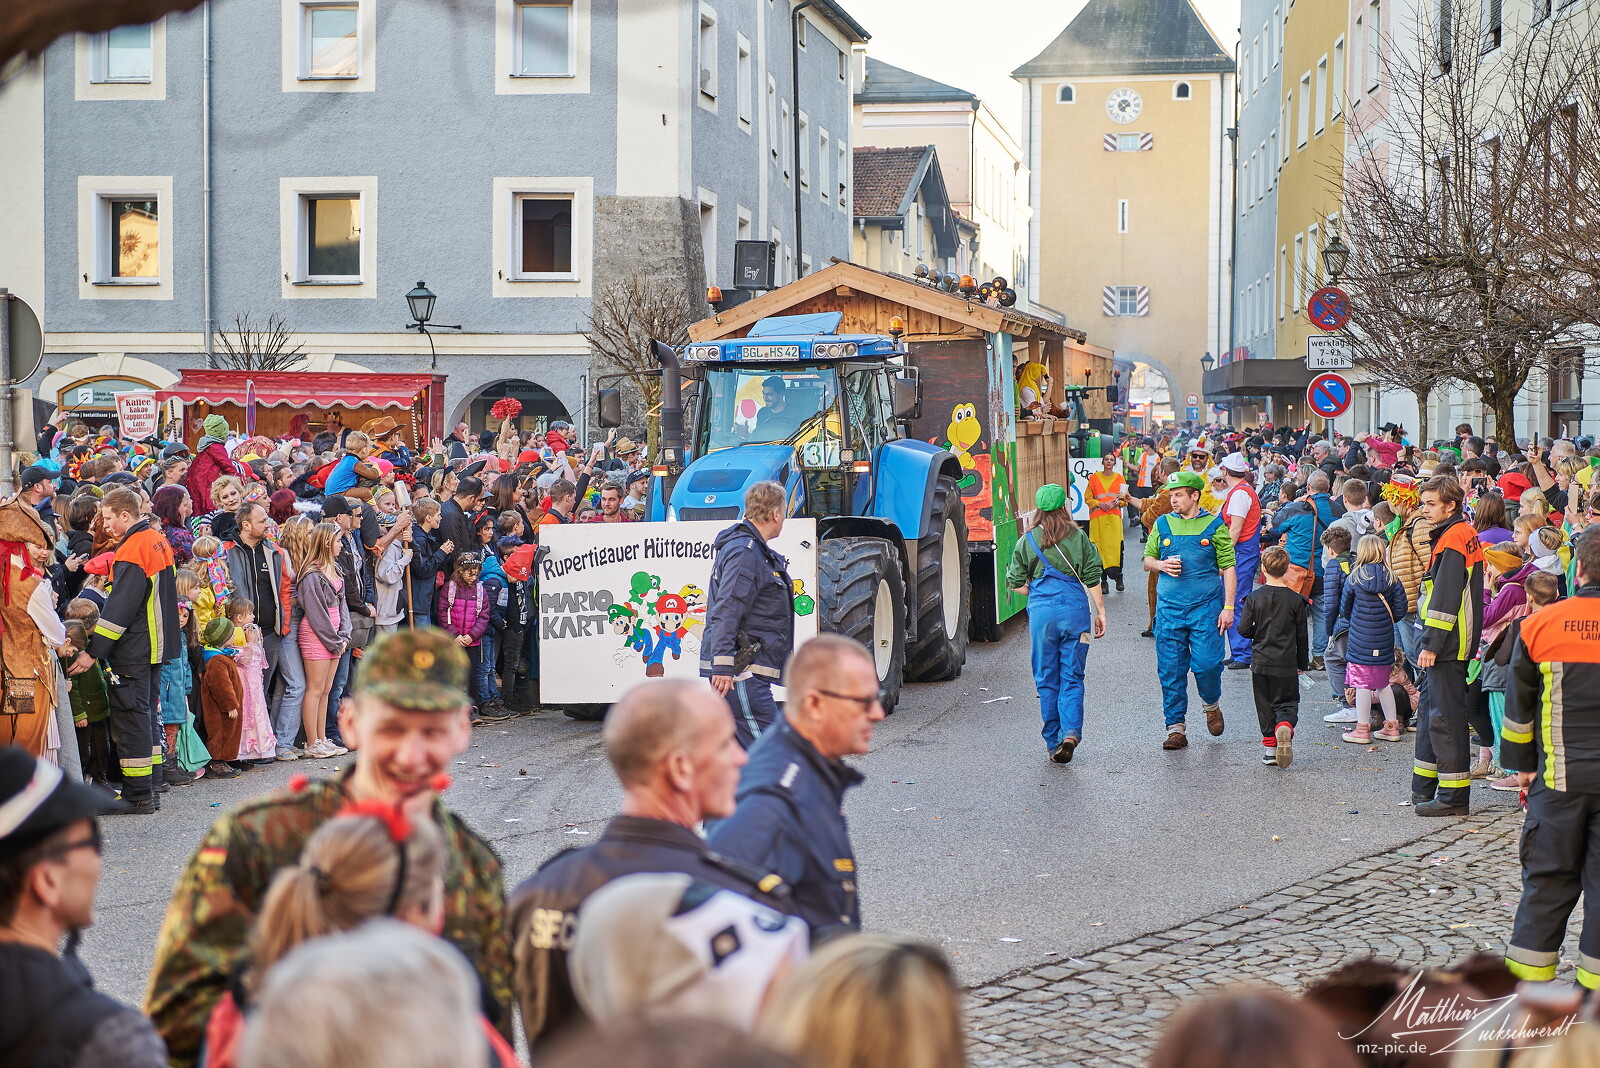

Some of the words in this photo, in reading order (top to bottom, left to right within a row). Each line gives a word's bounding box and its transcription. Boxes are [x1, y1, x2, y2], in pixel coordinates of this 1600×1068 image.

[1311, 340, 1350, 349] werktags
[743, 347, 763, 358] BGL
[769, 347, 784, 358] HS
[785, 346, 798, 358] 42
[1340, 357, 1345, 366] h
[125, 398, 151, 406] Kaffee
[123, 413, 155, 421] Cappuccino
[1170, 474, 1177, 482] L
[542, 543, 640, 581] Rupertigauer
[540, 589, 614, 613] MARIO
[542, 614, 609, 640] KART
